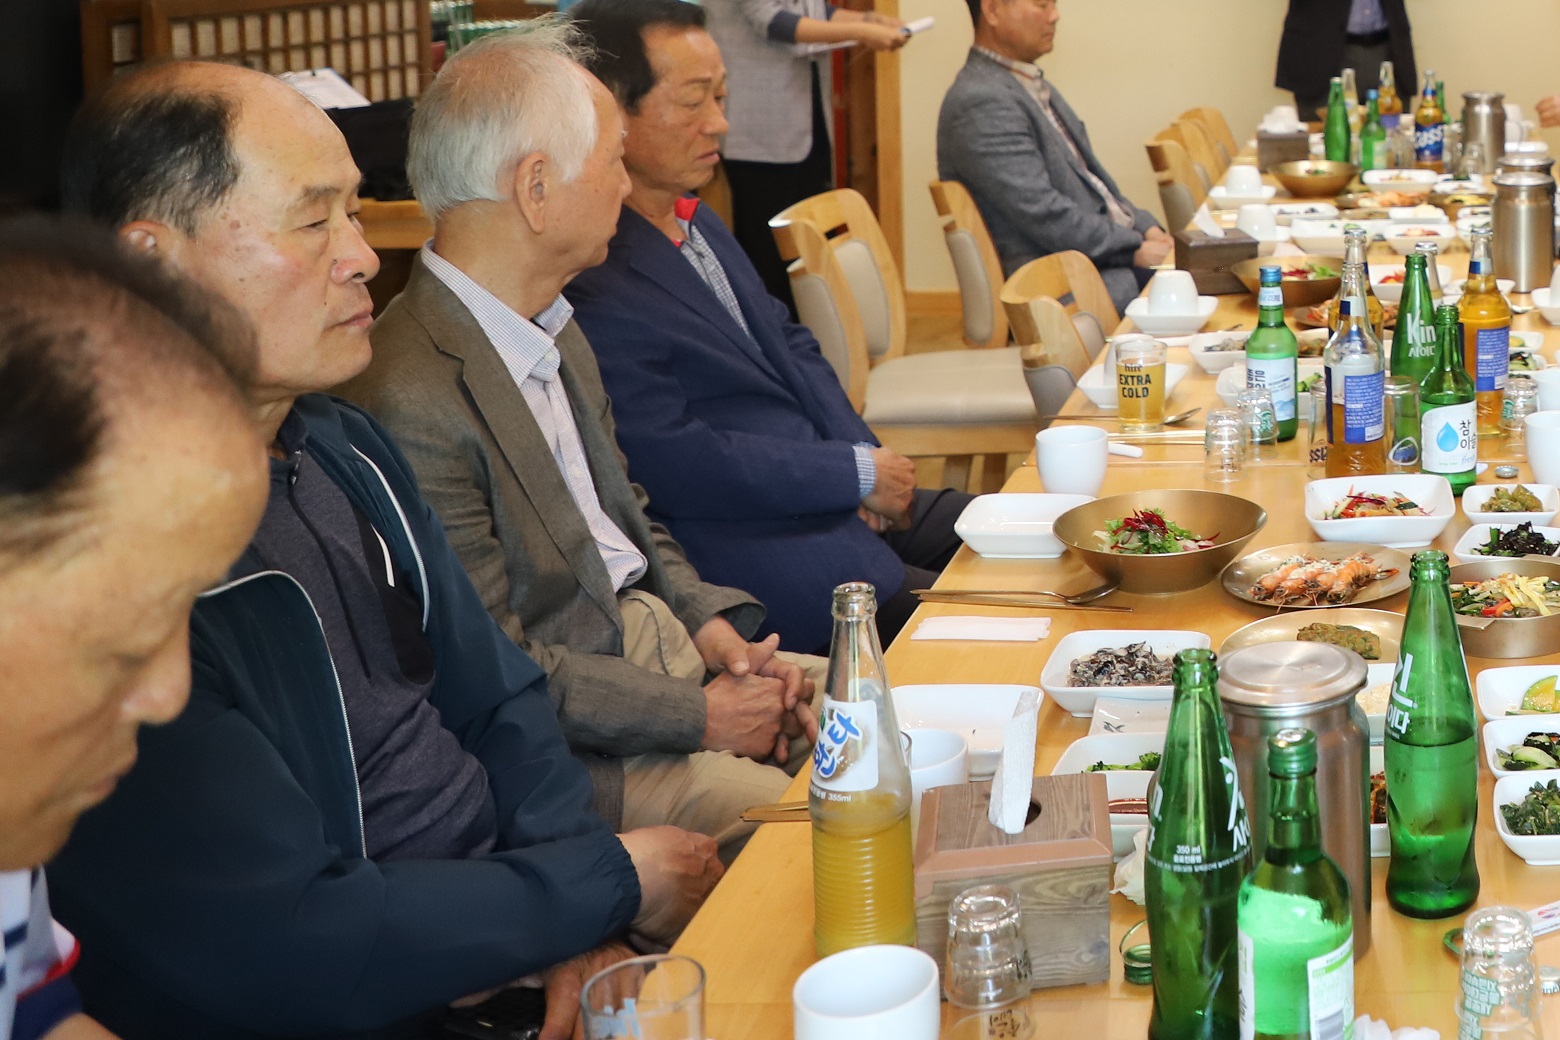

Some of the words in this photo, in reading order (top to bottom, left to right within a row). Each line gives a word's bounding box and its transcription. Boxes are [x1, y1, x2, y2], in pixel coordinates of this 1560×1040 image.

[1119, 373, 1152, 386] EXTRA
[1122, 386, 1149, 399] COLD
[1459, 419, 1471, 436] 참
